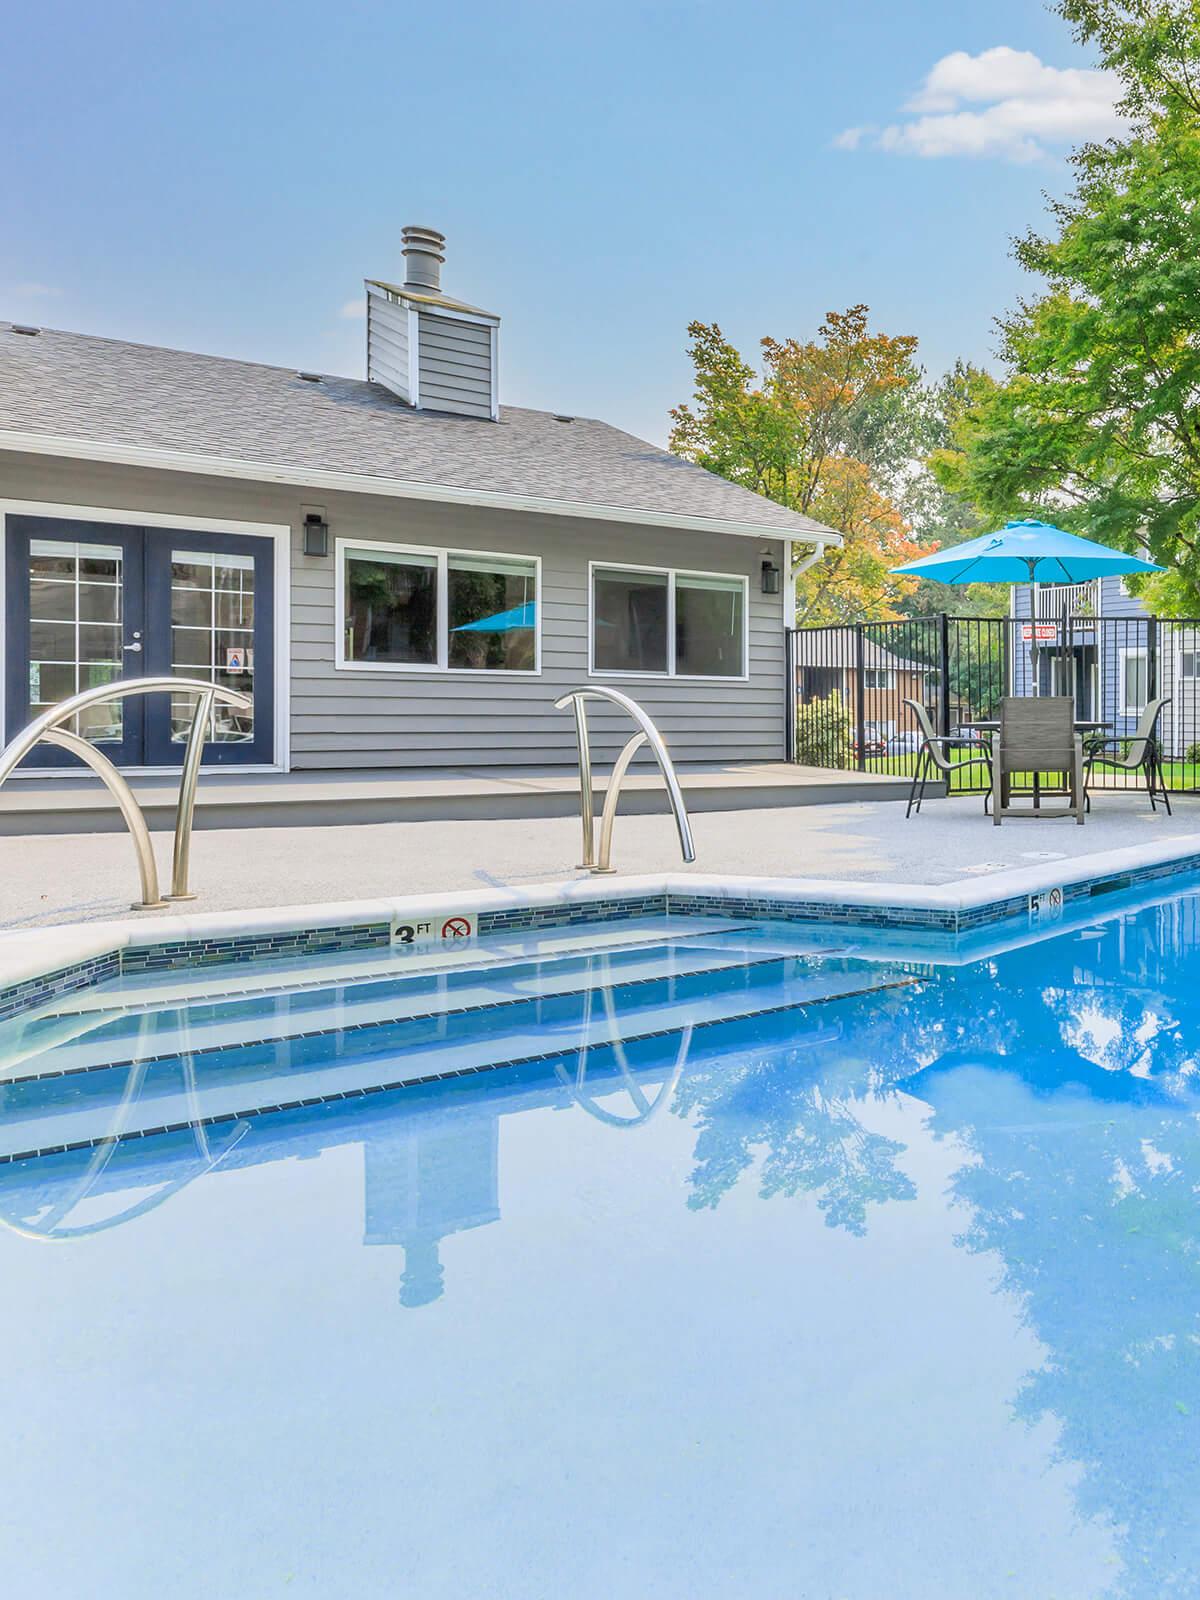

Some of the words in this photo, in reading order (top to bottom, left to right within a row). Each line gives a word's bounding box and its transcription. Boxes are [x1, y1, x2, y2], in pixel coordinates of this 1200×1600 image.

[1031, 895, 1039, 912] 5
[394, 925, 415, 944] 3
[417, 922, 431, 934] FT
